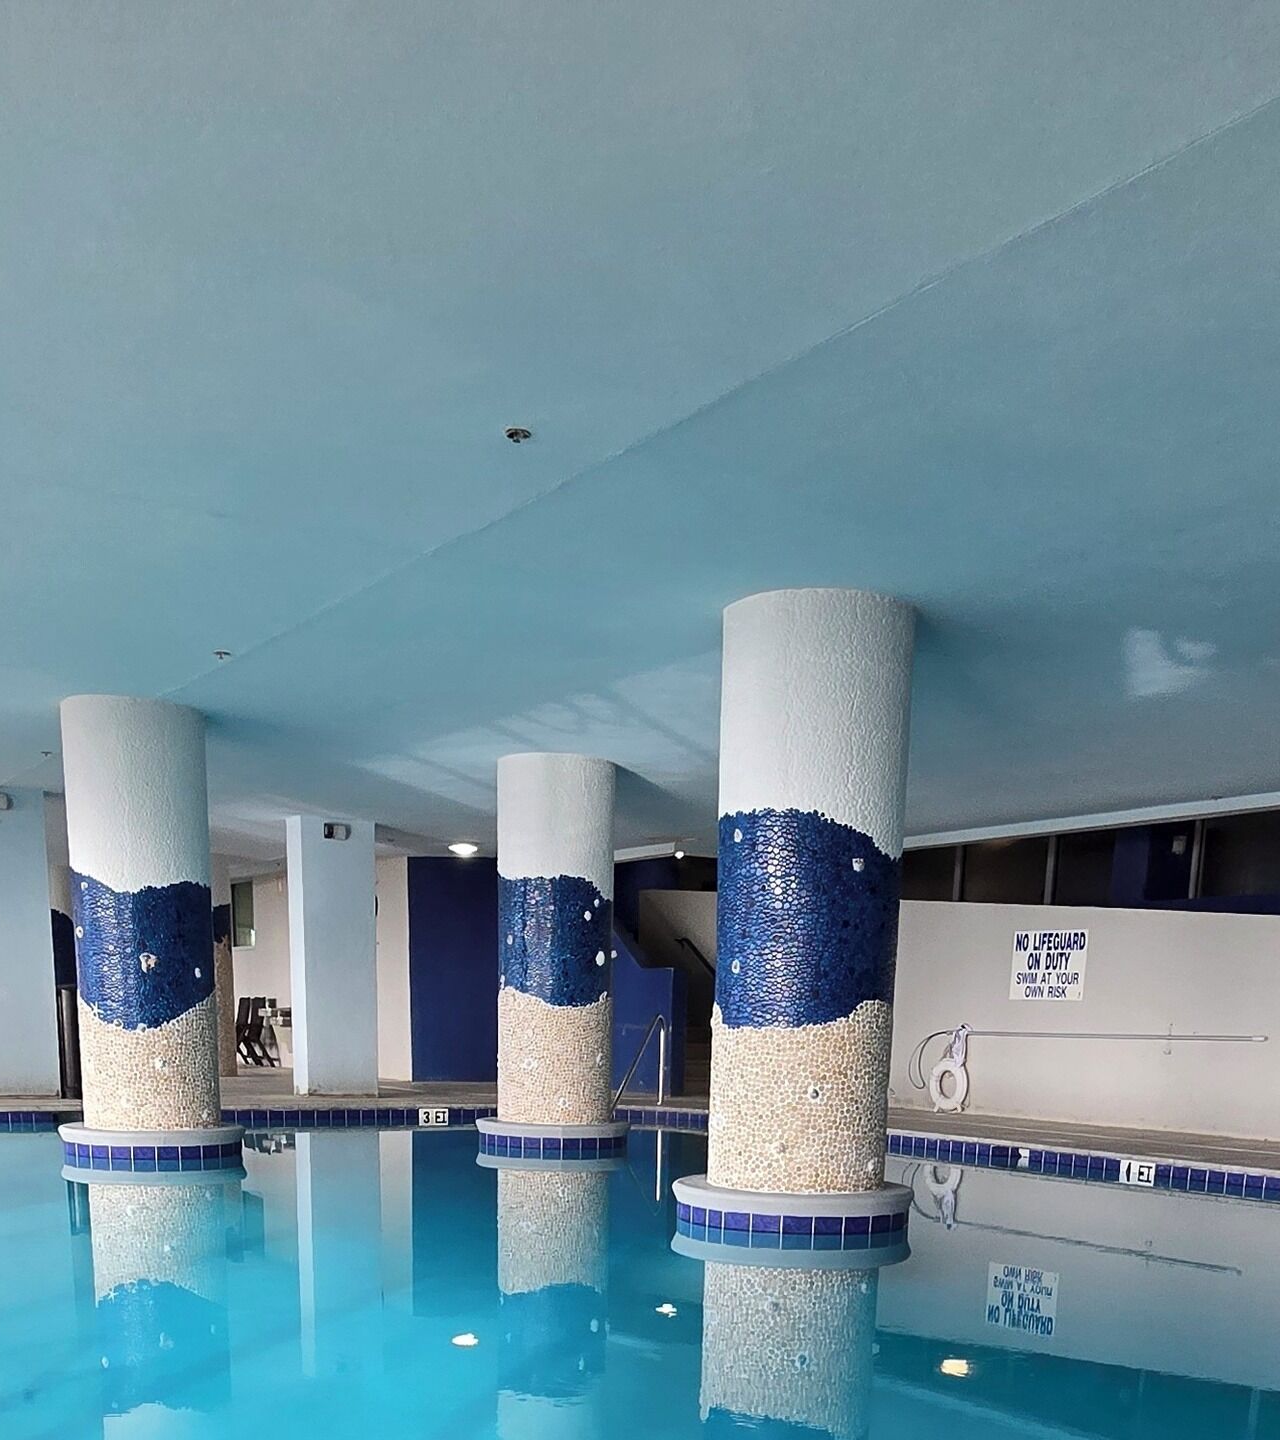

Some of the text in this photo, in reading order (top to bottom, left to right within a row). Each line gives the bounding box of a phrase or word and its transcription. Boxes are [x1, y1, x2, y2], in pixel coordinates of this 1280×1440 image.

[1015, 932, 1086, 951] NO LIFEGUARD
[1027, 952, 1071, 970] ON DUTY
[1016, 972, 1079, 984] SWIM AT YOUR
[1024, 985, 1067, 998] OWN RISK
